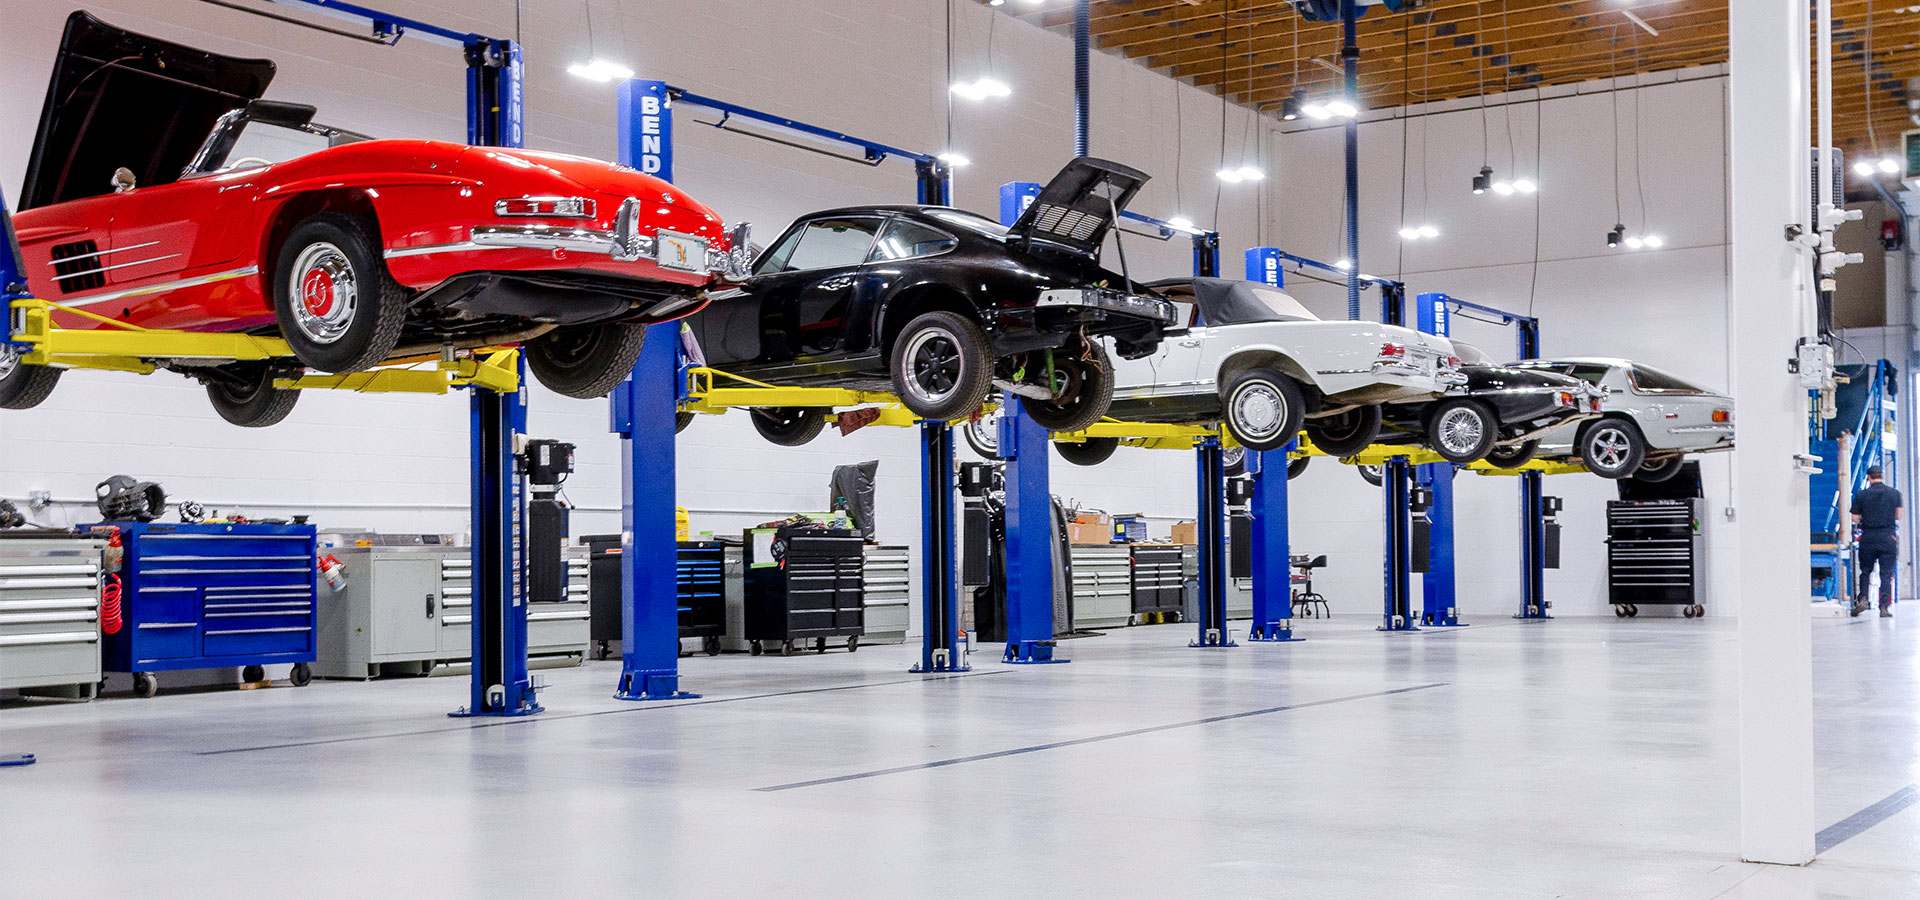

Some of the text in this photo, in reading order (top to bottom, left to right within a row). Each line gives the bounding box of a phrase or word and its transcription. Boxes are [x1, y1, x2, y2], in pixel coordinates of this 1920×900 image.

[511, 59, 521, 144] BEND
[641, 96, 661, 173] BEND
[1265, 257, 1277, 287] BE
[1434, 301, 1445, 337] BEN
